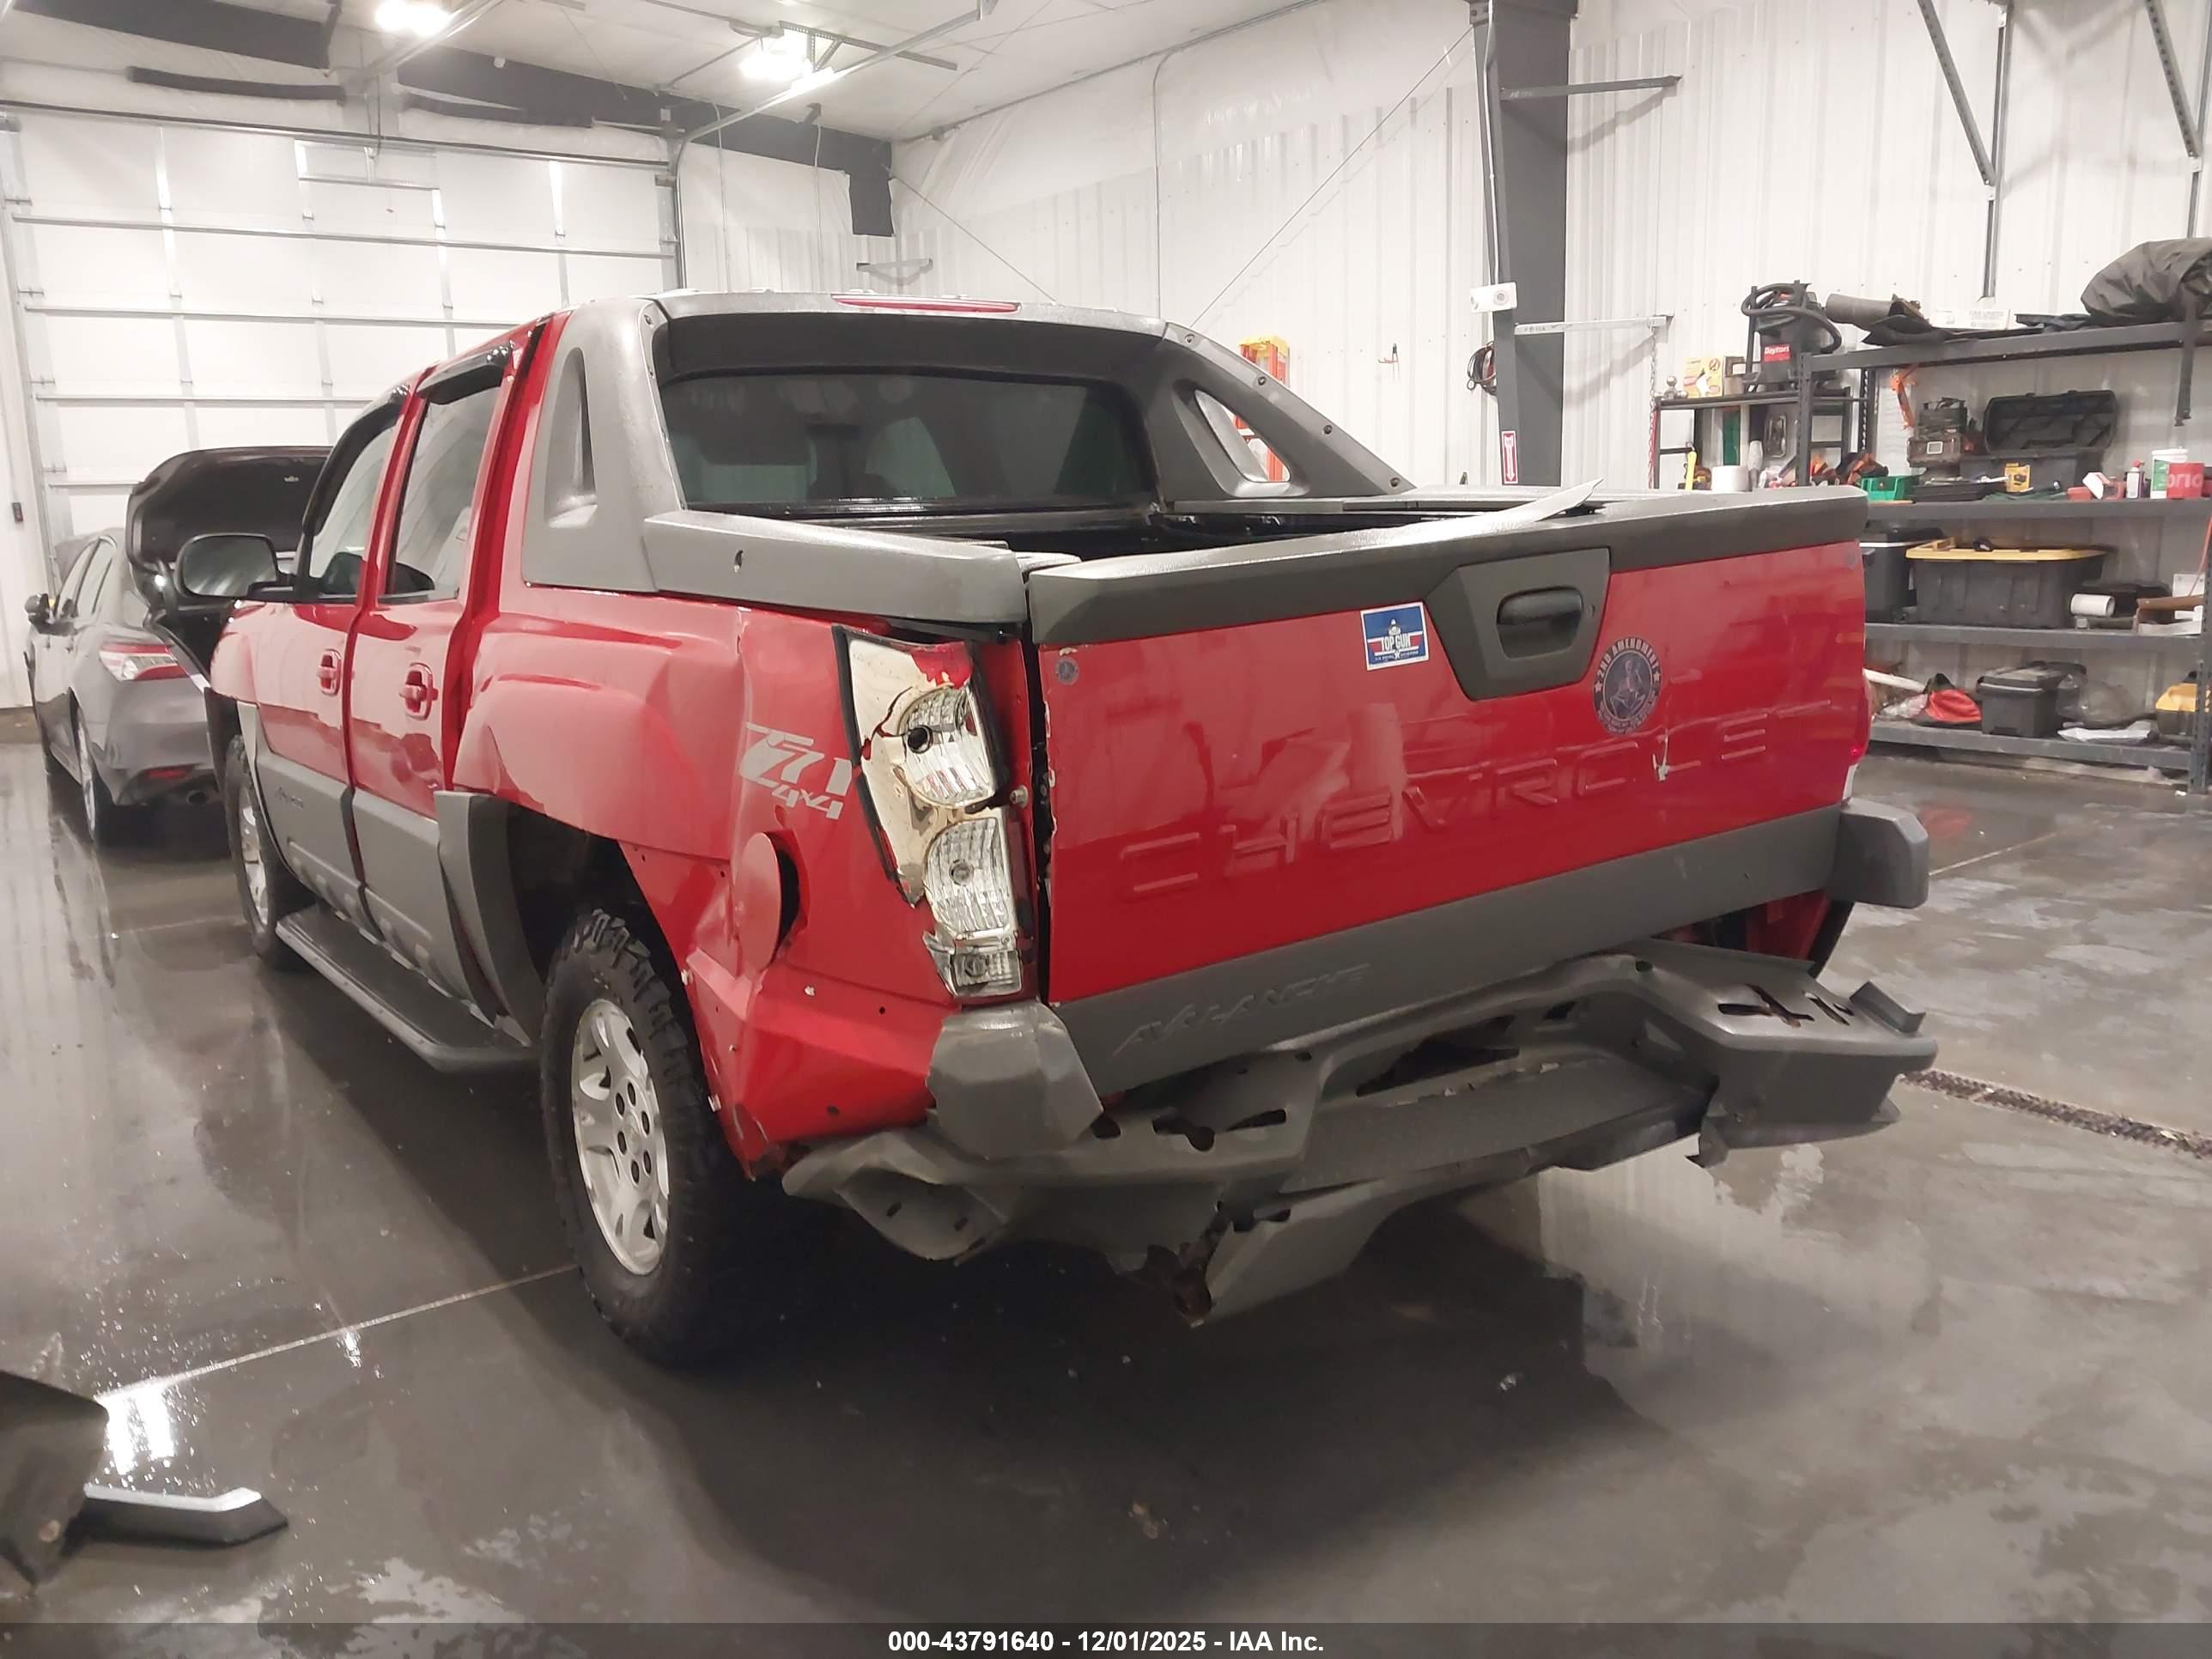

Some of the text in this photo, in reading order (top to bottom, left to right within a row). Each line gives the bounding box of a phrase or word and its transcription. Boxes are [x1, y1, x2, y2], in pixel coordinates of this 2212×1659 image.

[1381, 633, 1412, 652] TOP GUN
[739, 721, 853, 797] Z71
